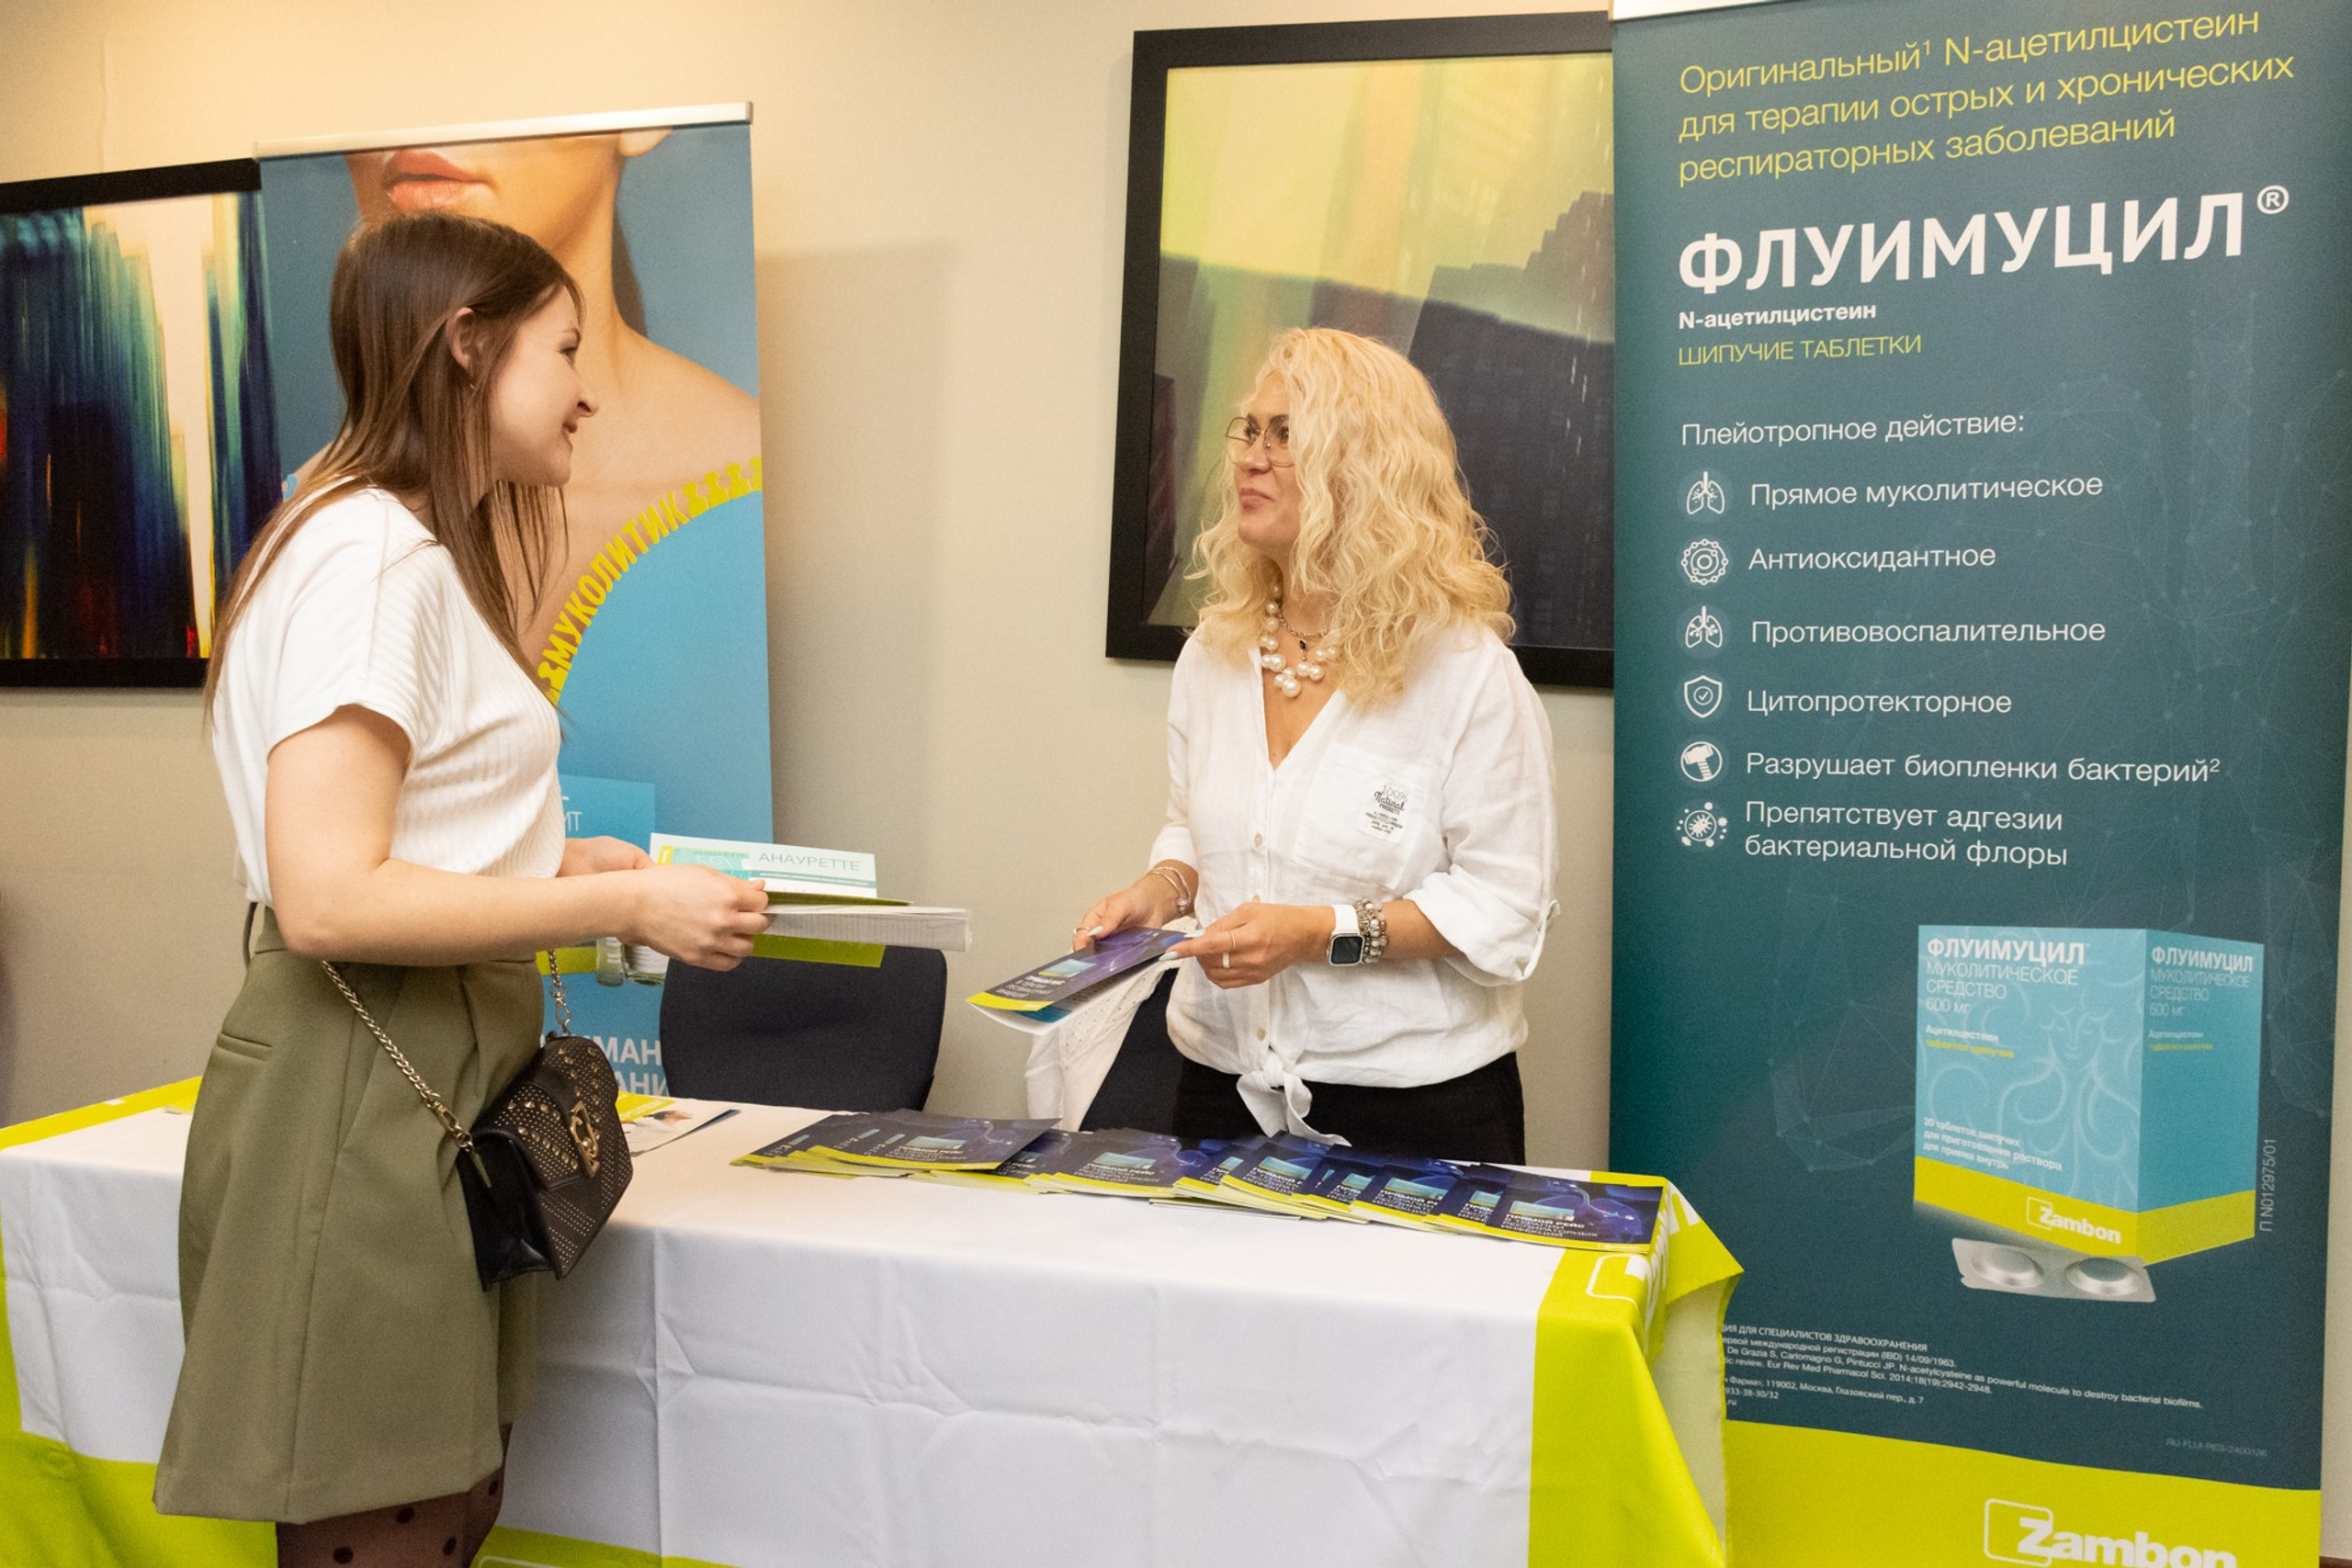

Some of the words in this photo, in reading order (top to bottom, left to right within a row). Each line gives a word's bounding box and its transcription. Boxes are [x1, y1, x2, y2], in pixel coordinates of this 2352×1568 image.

[1946, 12, 2258, 65] N-ацетилцистеин
[1679, 114, 1734, 143] для
[1746, 100, 1878, 134] терапии
[1891, 85, 2013, 118] острых
[2027, 82, 2044, 103] и
[2057, 57, 2293, 104] хронических
[1680, 140, 1934, 187] респираторных
[1947, 109, 2174, 158] заболеваний
[1679, 305, 1876, 329] N-ацетилцистеин
[1679, 342, 1793, 365] ШИПУЧИЕ
[1801, 335, 1920, 357] ТАБЛЕТКИ
[1682, 422, 1876, 446] Плейотропное
[1885, 414, 2023, 442] действие:
[1752, 484, 1857, 510] Прямое
[1867, 478, 2102, 507] муколитическое
[1748, 548, 1996, 572] Антиоксидантное
[1752, 621, 2106, 648] Противовоспалительное
[1748, 690, 2011, 717] Цитопротекторное
[1747, 752, 1895, 779] Разрушает
[1905, 754, 2056, 779] биопленки
[1747, 801, 1938, 829] Препятствует
[1947, 810, 2062, 832] адгезии
[758, 852, 860, 872] АНАУРЕТТЕ
[1746, 834, 1955, 862] бактериальной
[1967, 840, 2066, 869] флоры
[1927, 938, 2086, 967] ФЛУИМУЦИЛ
[2152, 946, 2253, 974] ФЛУИМУЦИЛ
[1927, 962, 2078, 986] МУКОЛИТИЧЕСКОЕ
[1926, 979, 2007, 999] СРЕДСТВО
[1926, 998, 1951, 1012] 600
[2040, 1206, 2121, 1245] Zambon
[1738, 1325, 1757, 1335] ДЛЯ
[1758, 1327, 1833, 1341] СПЕЦИАЛИСТОВ
[1834, 1334, 1928, 1352] ЗДРАВООХРАНЕНИЯ
[1986, 1376, 2027, 1388] powerful
[2028, 1382, 2070, 1394] molecule
[2084, 1390, 2119, 1402] destroy
[2120, 1393, 2161, 1404] bacterial
[2018, 1517, 2237, 1568] Zambon
